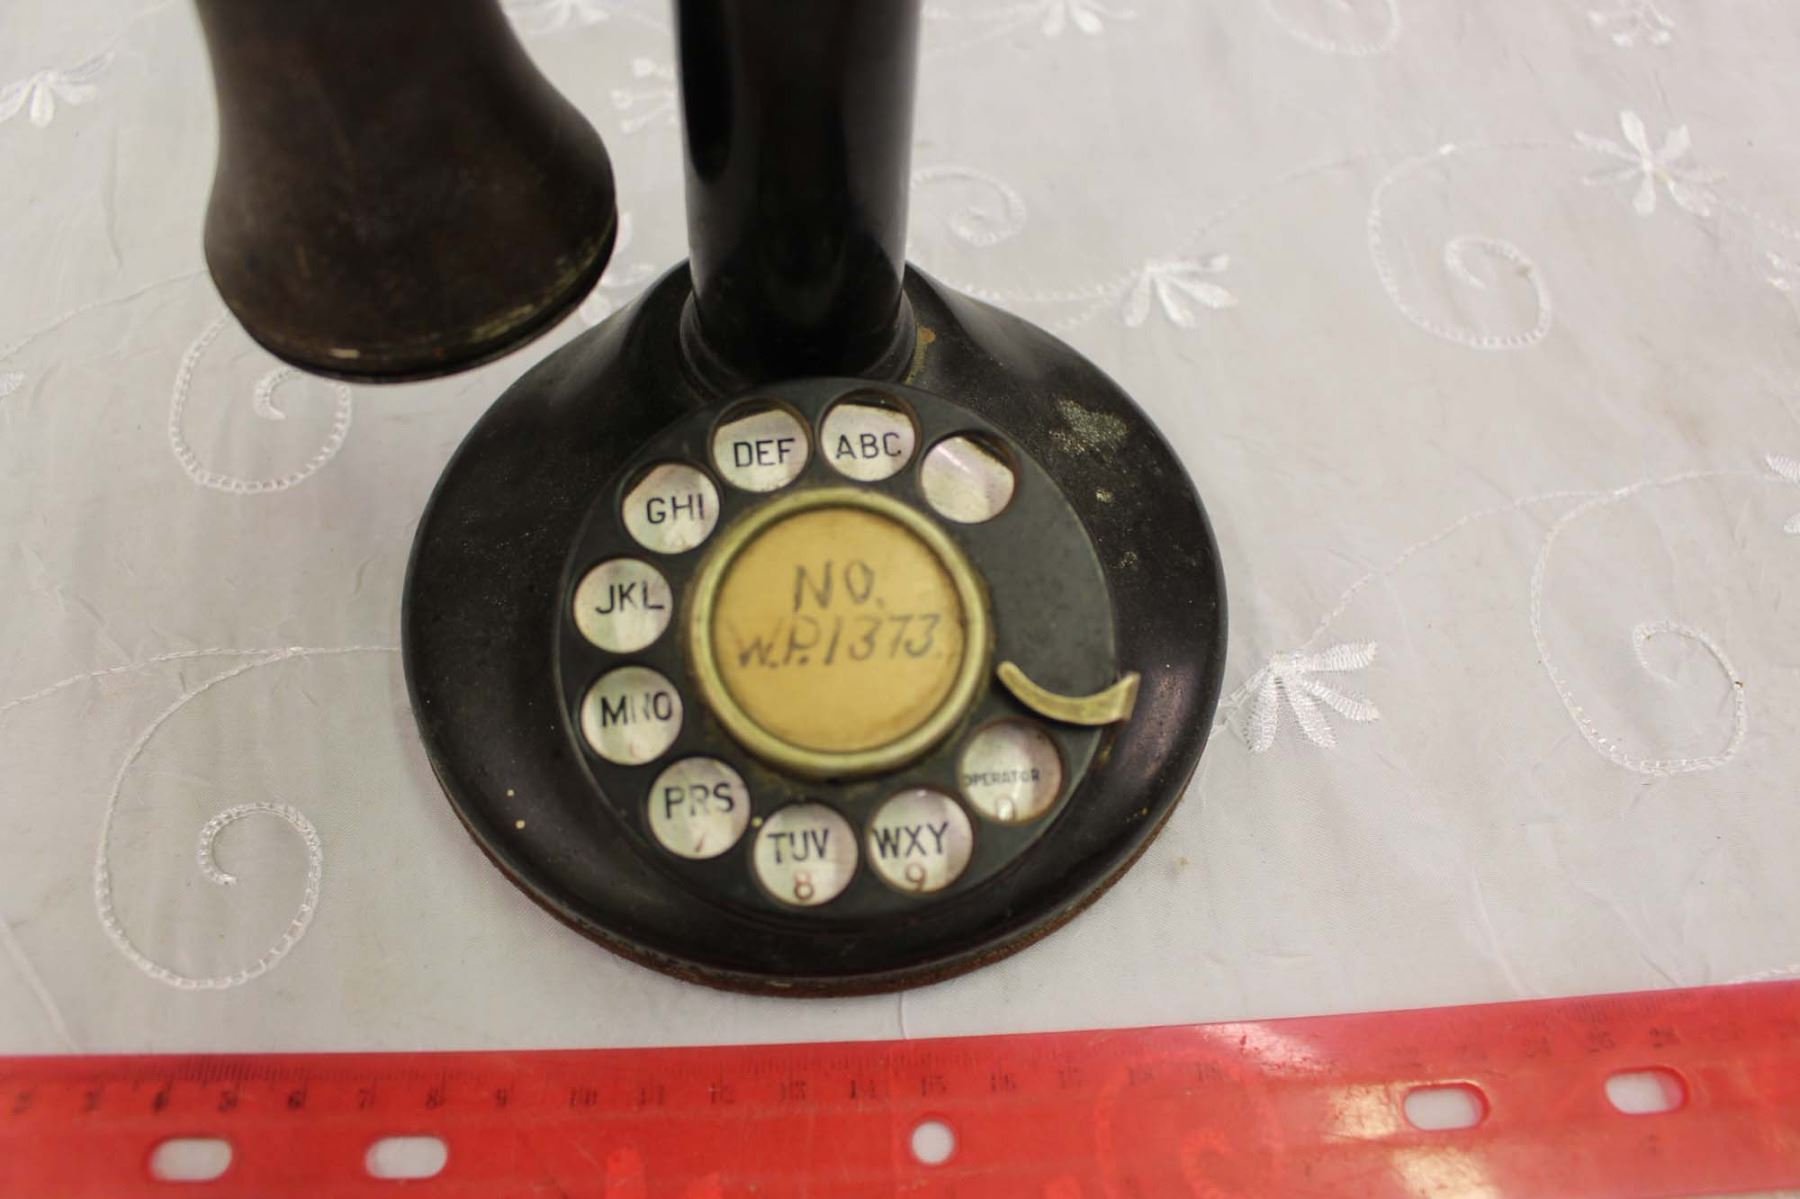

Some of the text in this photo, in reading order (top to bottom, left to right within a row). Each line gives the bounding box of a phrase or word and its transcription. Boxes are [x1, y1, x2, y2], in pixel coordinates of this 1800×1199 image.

[733, 437, 795, 468] DEF
[835, 432, 902, 460] ABC
[646, 493, 705, 525] GHI
[595, 580, 665, 614] JKL
[601, 690, 674, 728] MNO
[964, 768, 1040, 788] OPERATOR
[664, 781, 735, 819] PRS
[767, 828, 829, 864] TUV
[873, 821, 949, 859] WXY
[794, 869, 815, 901] 8
[905, 862, 926, 892] 9
